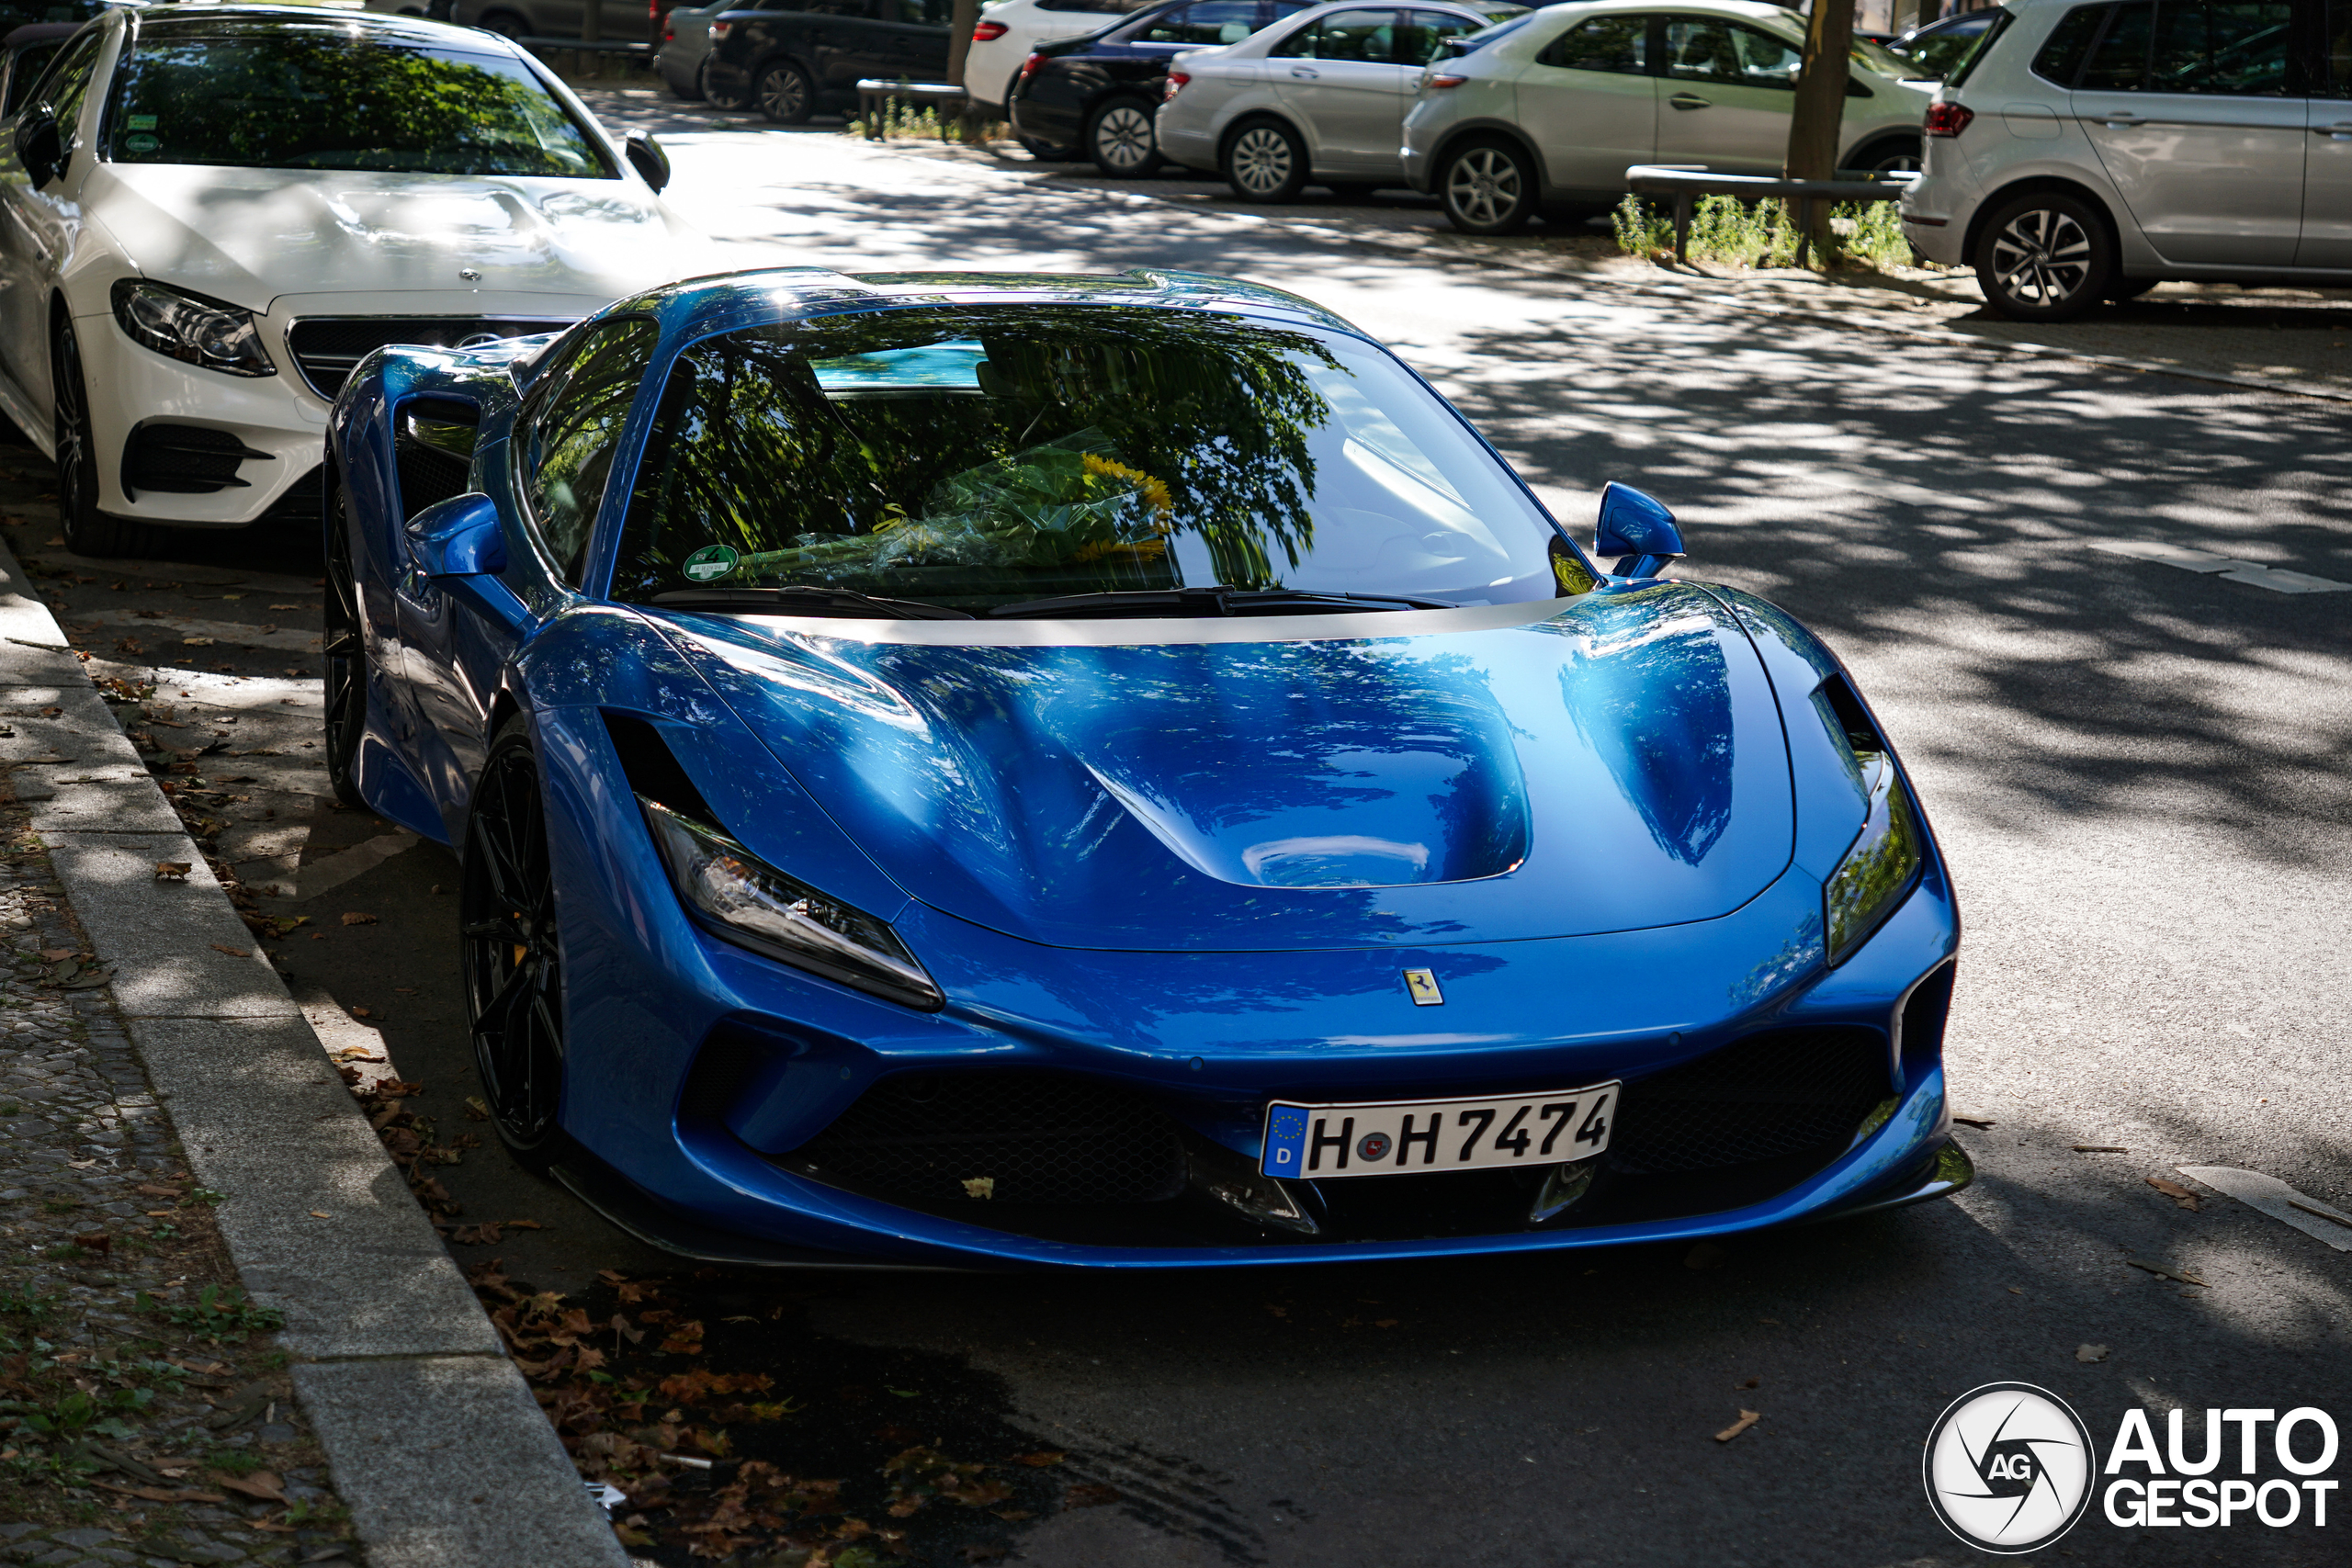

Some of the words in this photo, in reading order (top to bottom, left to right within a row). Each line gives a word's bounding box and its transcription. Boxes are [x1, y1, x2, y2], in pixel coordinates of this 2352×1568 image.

[705, 547, 719, 563] 4
[1307, 1116, 1355, 1171] H
[1396, 1111, 1442, 1167] H
[1457, 1093, 1609, 1162] 7474
[1275, 1148, 1292, 1165] D
